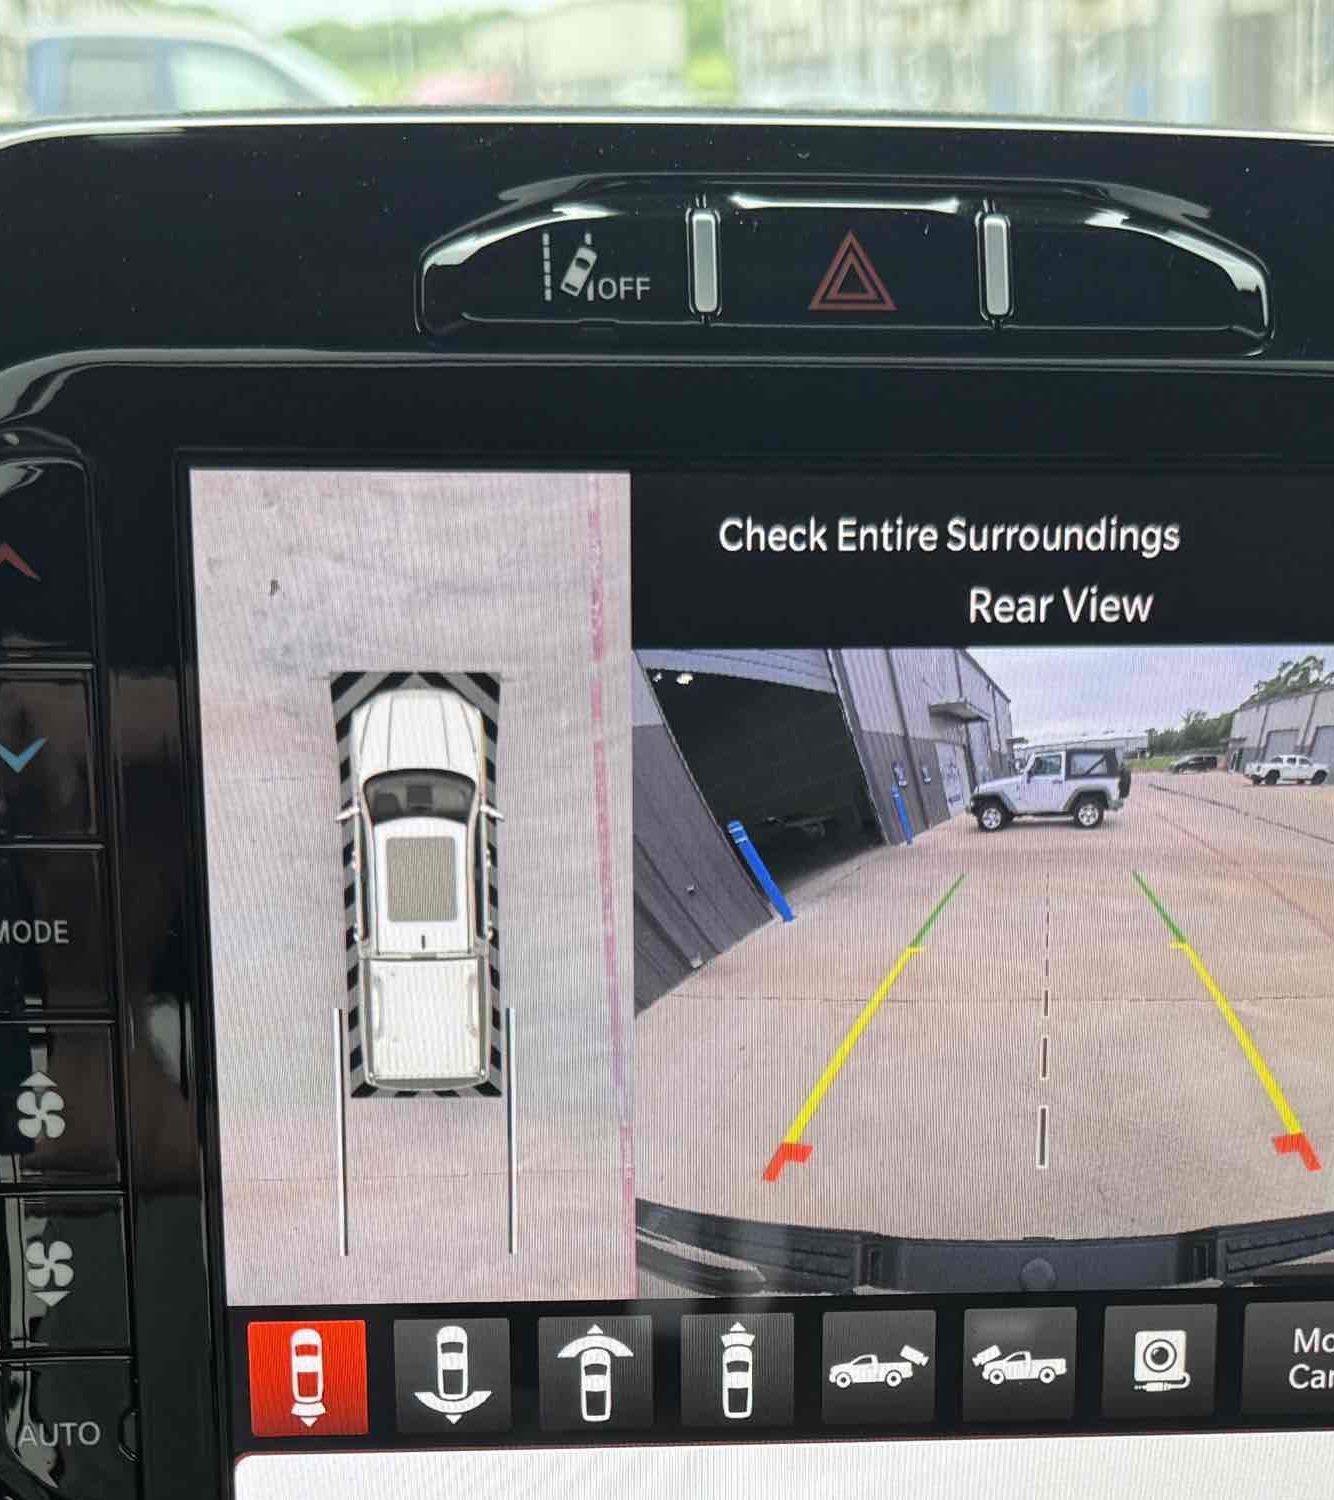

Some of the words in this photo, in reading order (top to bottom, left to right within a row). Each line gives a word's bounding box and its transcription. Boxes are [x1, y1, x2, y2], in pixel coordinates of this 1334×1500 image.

[598, 277, 651, 301] OFF
[719, 517, 828, 555] Check
[837, 519, 939, 553] Entire
[947, 517, 1181, 559] Surroundings
[969, 588, 1053, 624] Rear
[1062, 589, 1154, 623] View
[18, 1419, 101, 1448] AUTO
